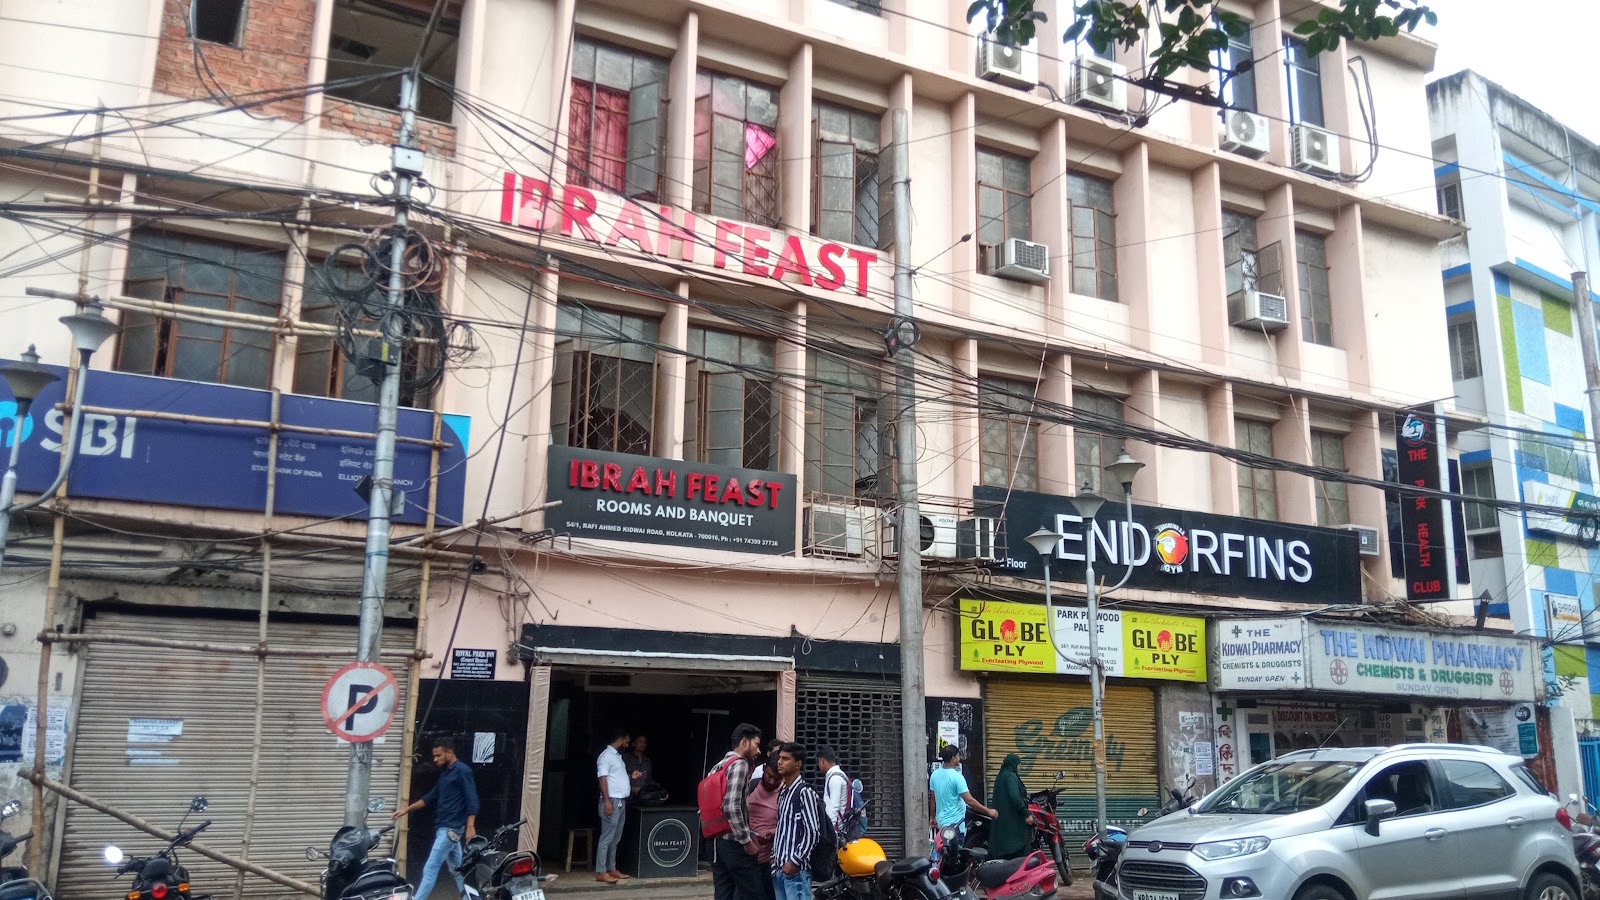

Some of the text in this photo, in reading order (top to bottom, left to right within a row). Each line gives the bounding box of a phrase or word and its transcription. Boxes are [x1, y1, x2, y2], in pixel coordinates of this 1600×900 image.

[500, 172, 877, 297] IBRAH FEAST
[40, 407, 137, 458] SBI
[1408, 448, 1427, 461] THE
[251, 464, 270, 472] STAT
[303, 470, 323, 478] INDIA
[569, 458, 783, 509] IBRAH FEAST
[1414, 479, 1427, 510] PRK
[596, 498, 753, 527] ROOMS AND BANQUET
[599, 524, 622, 532] AHMED
[622, 526, 645, 534] KIDWAI
[646, 528, 665, 537] ROAD,
[666, 530, 694, 539] KOLKATA
[1417, 523, 1431, 567] HEALTH
[1006, 558, 1028, 569] Floor
[1164, 564, 1183, 574] GYM
[1413, 579, 1441, 593] CLUB
[1057, 609, 1079, 620] PARK
[971, 618, 1047, 643] GLOBE
[1246, 628, 1271, 637] THE
[1132, 629, 1198, 653] GLOBE
[1221, 640, 1302, 656] KIDWAI PHARMACY
[994, 644, 1025, 656] PLY
[1320, 628, 1524, 672] THE KIDWAI PHARMACY
[981, 658, 1017, 666] Everlasting
[1152, 653, 1179, 665] PLY
[1222, 662, 1254, 670] CHEMISTS
[1261, 660, 1302, 668] DRUGGISTS
[1141, 665, 1173, 673] Everlasting
[1356, 662, 1415, 681] CHEMISTS
[1418, 669, 1427, 681] &
[1431, 669, 1494, 686] DRUGGISTS
[1396, 683, 1459, 695] SUNDAY OPEN
